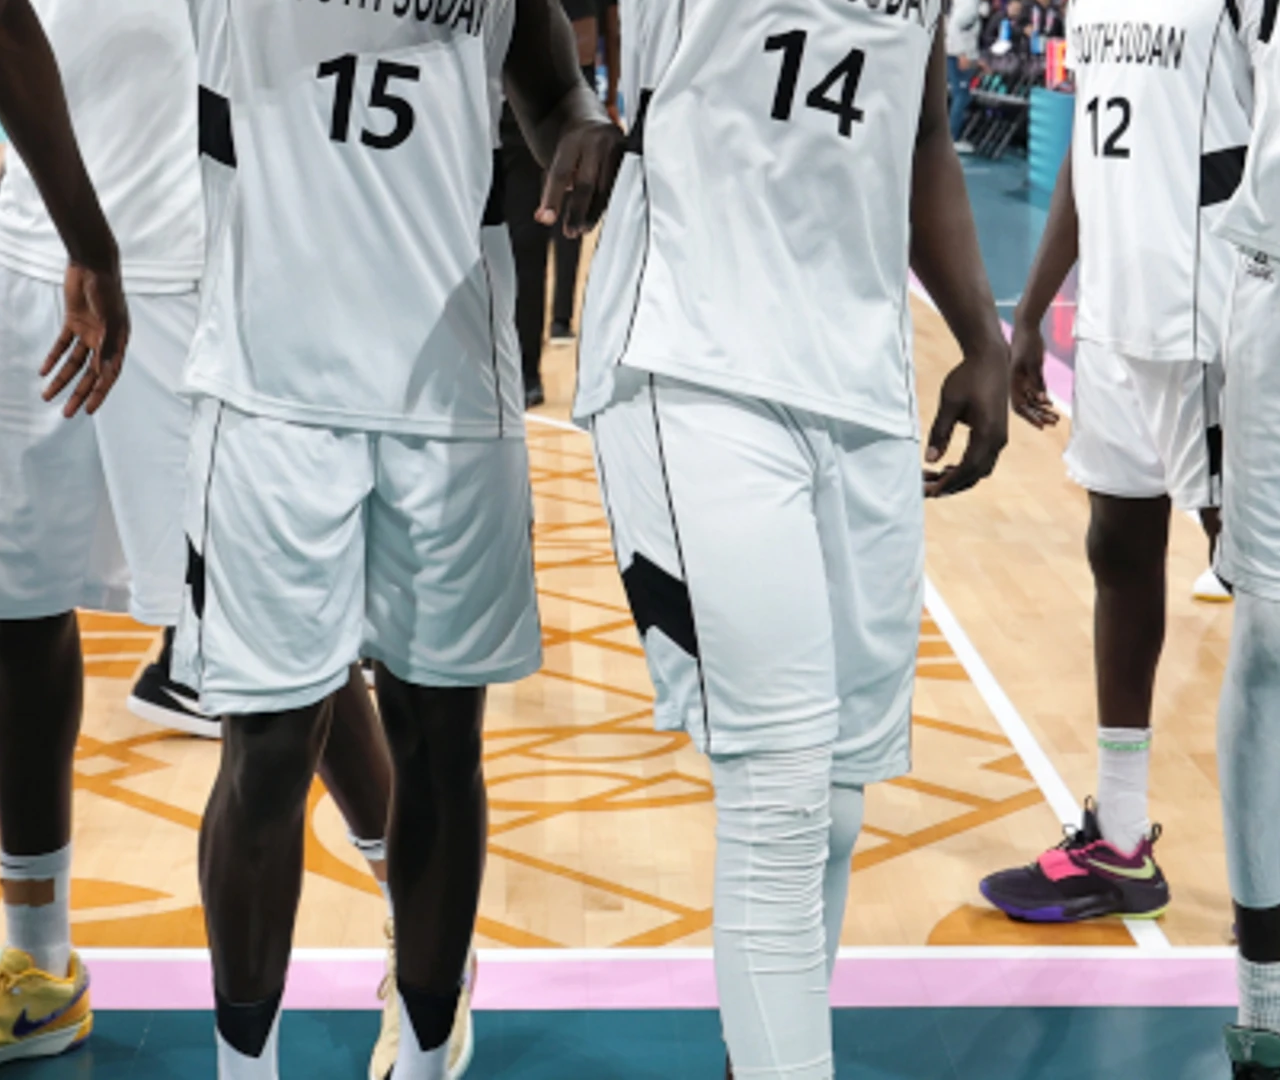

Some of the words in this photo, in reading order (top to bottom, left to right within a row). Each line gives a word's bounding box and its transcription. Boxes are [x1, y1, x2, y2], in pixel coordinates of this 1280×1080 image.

[764, 30, 866, 138] 14
[1116, 21, 1186, 70] SUDAN
[316, 54, 420, 150] 15
[1086, 95, 1131, 159] 12
